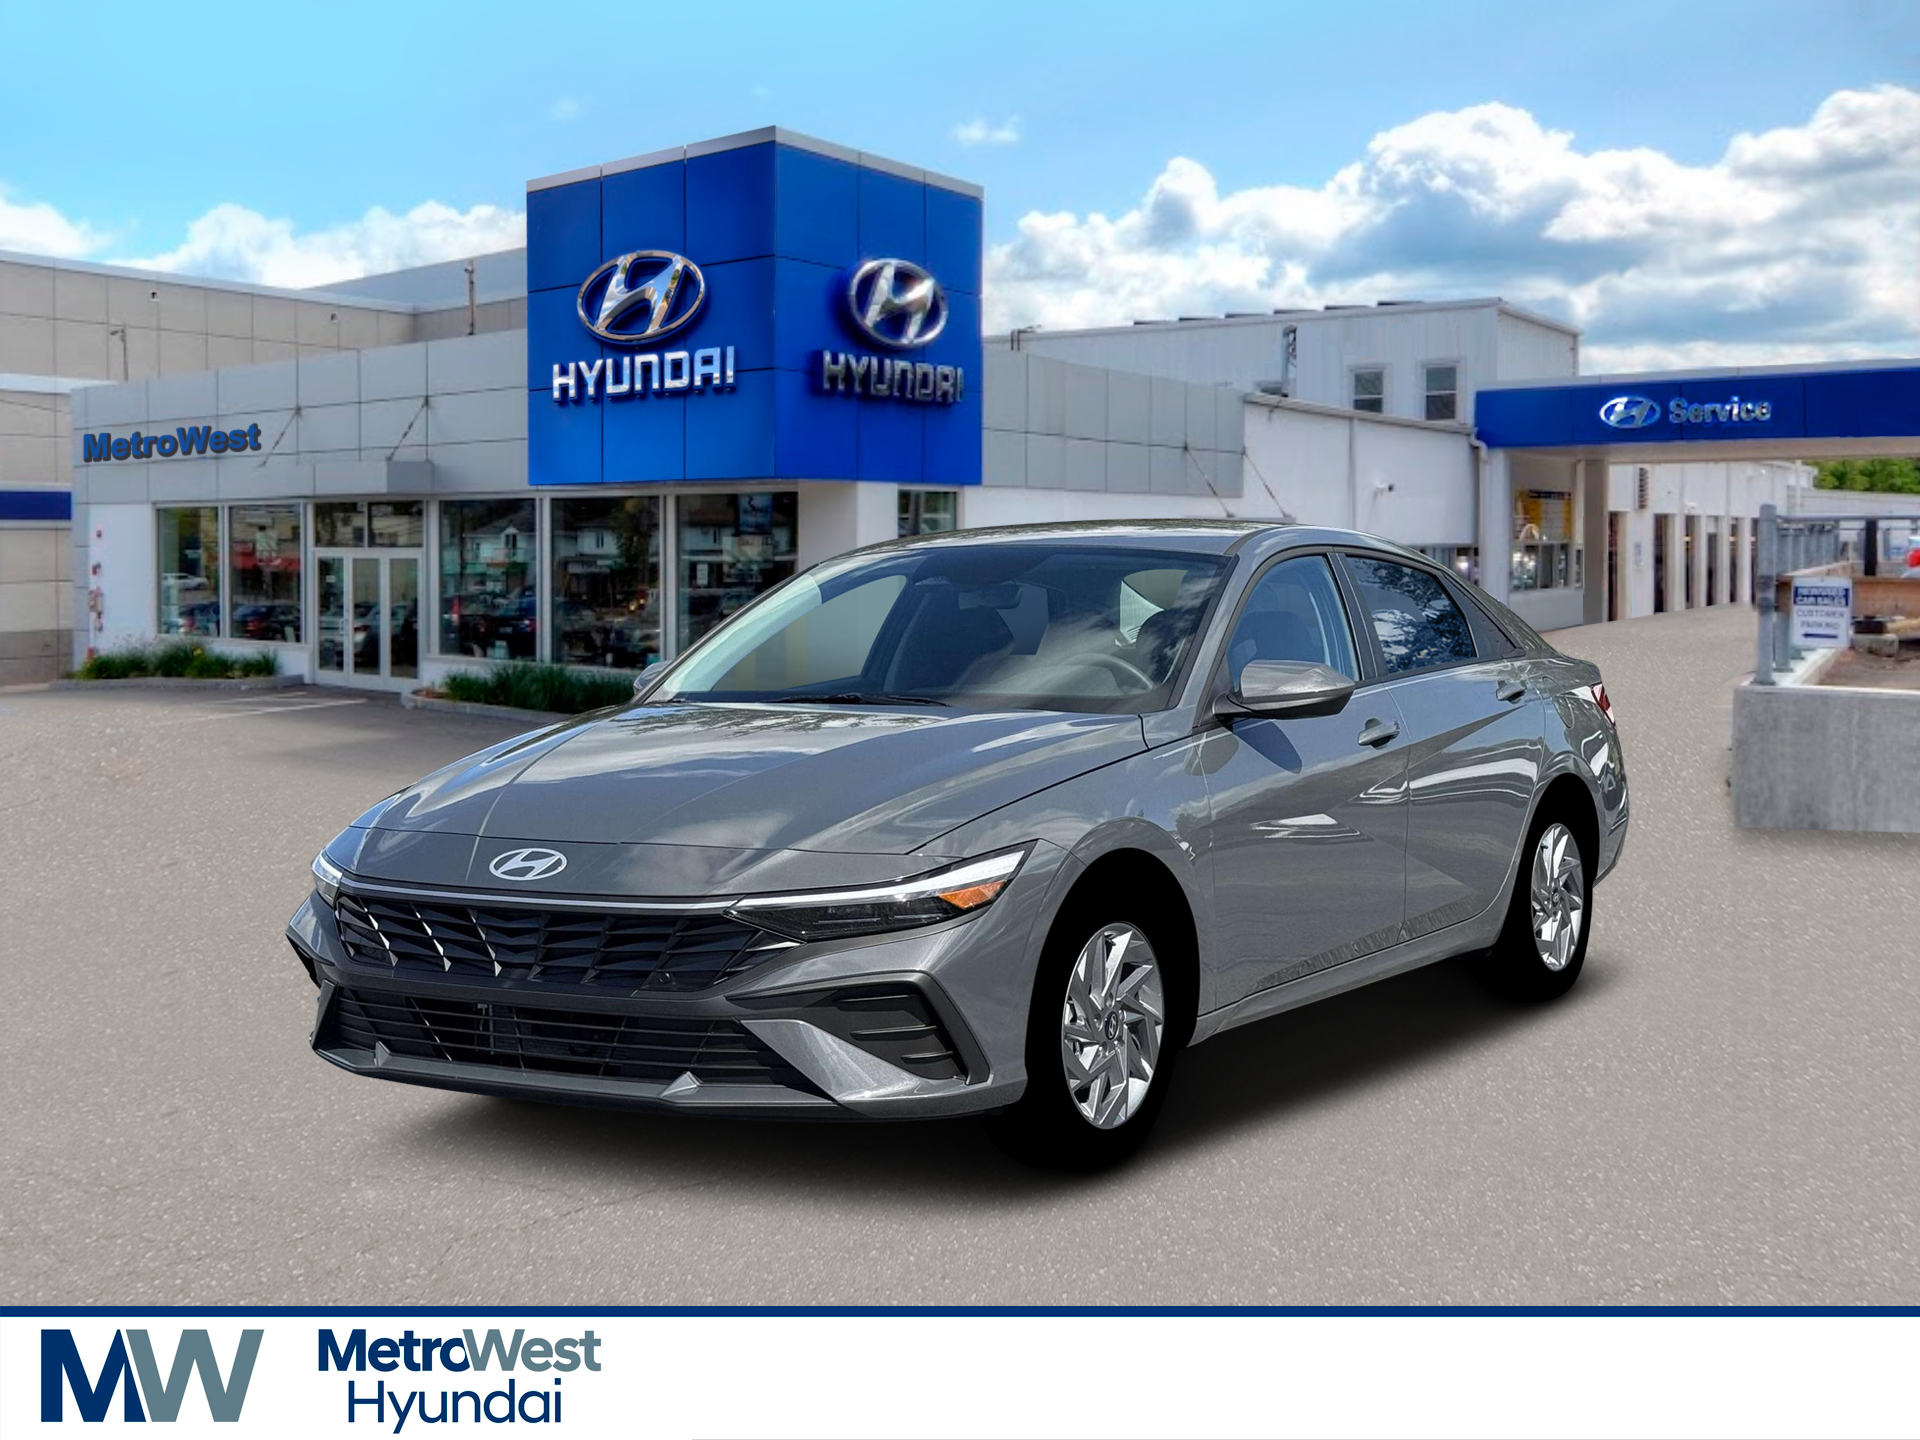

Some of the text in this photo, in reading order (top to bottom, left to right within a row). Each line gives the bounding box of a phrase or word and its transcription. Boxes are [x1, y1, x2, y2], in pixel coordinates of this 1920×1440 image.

[552, 346, 735, 402] HYUNDAI
[822, 349, 964, 404] HYUNDAI
[1669, 395, 1772, 424] Service
[83, 423, 261, 462] MetroWest
[1796, 608, 1845, 618] CUSTOMER
[1800, 620, 1840, 630] PARKING
